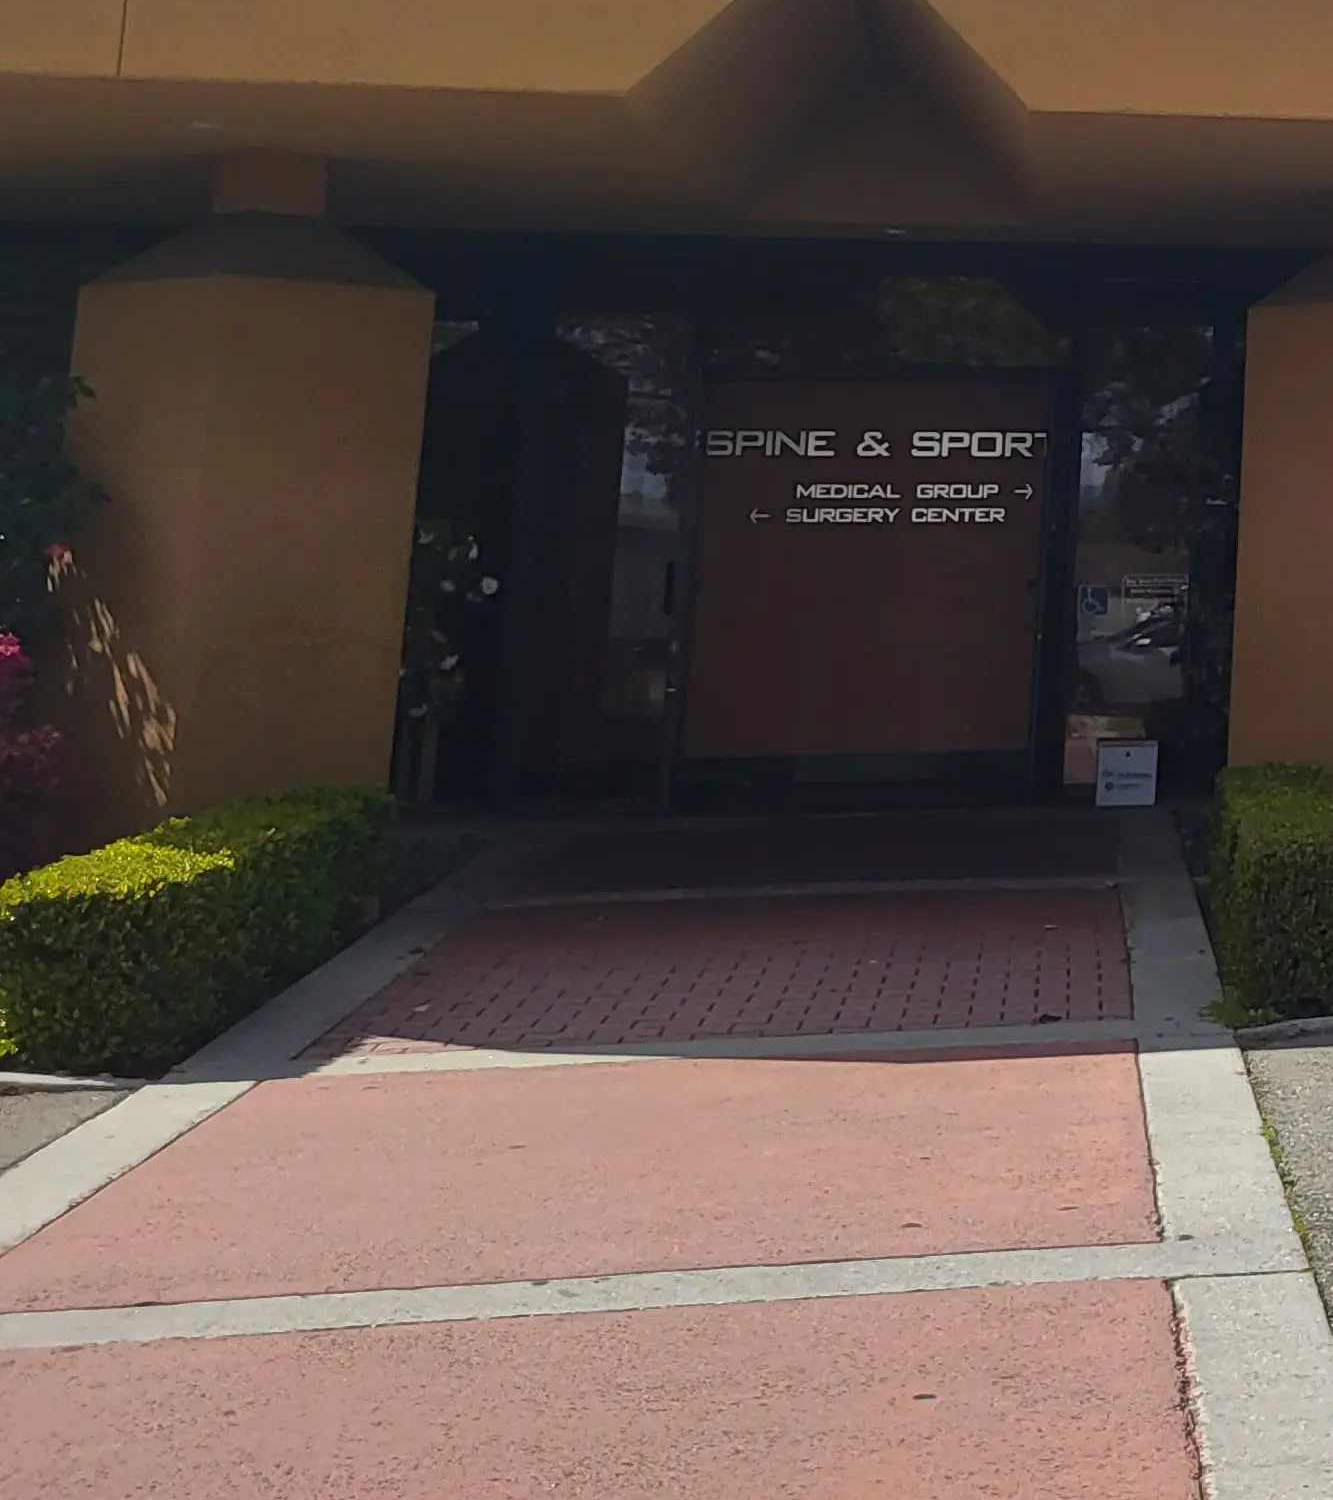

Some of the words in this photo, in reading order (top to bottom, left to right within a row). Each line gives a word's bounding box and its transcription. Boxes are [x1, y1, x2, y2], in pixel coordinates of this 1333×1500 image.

[706, 430, 836, 457] SPINE
[856, 431, 891, 458] &
[795, 483, 901, 500] MEDICAL
[916, 483, 1000, 500] GROUP
[785, 507, 901, 523] SURGERY
[911, 507, 1006, 523] CENTER
